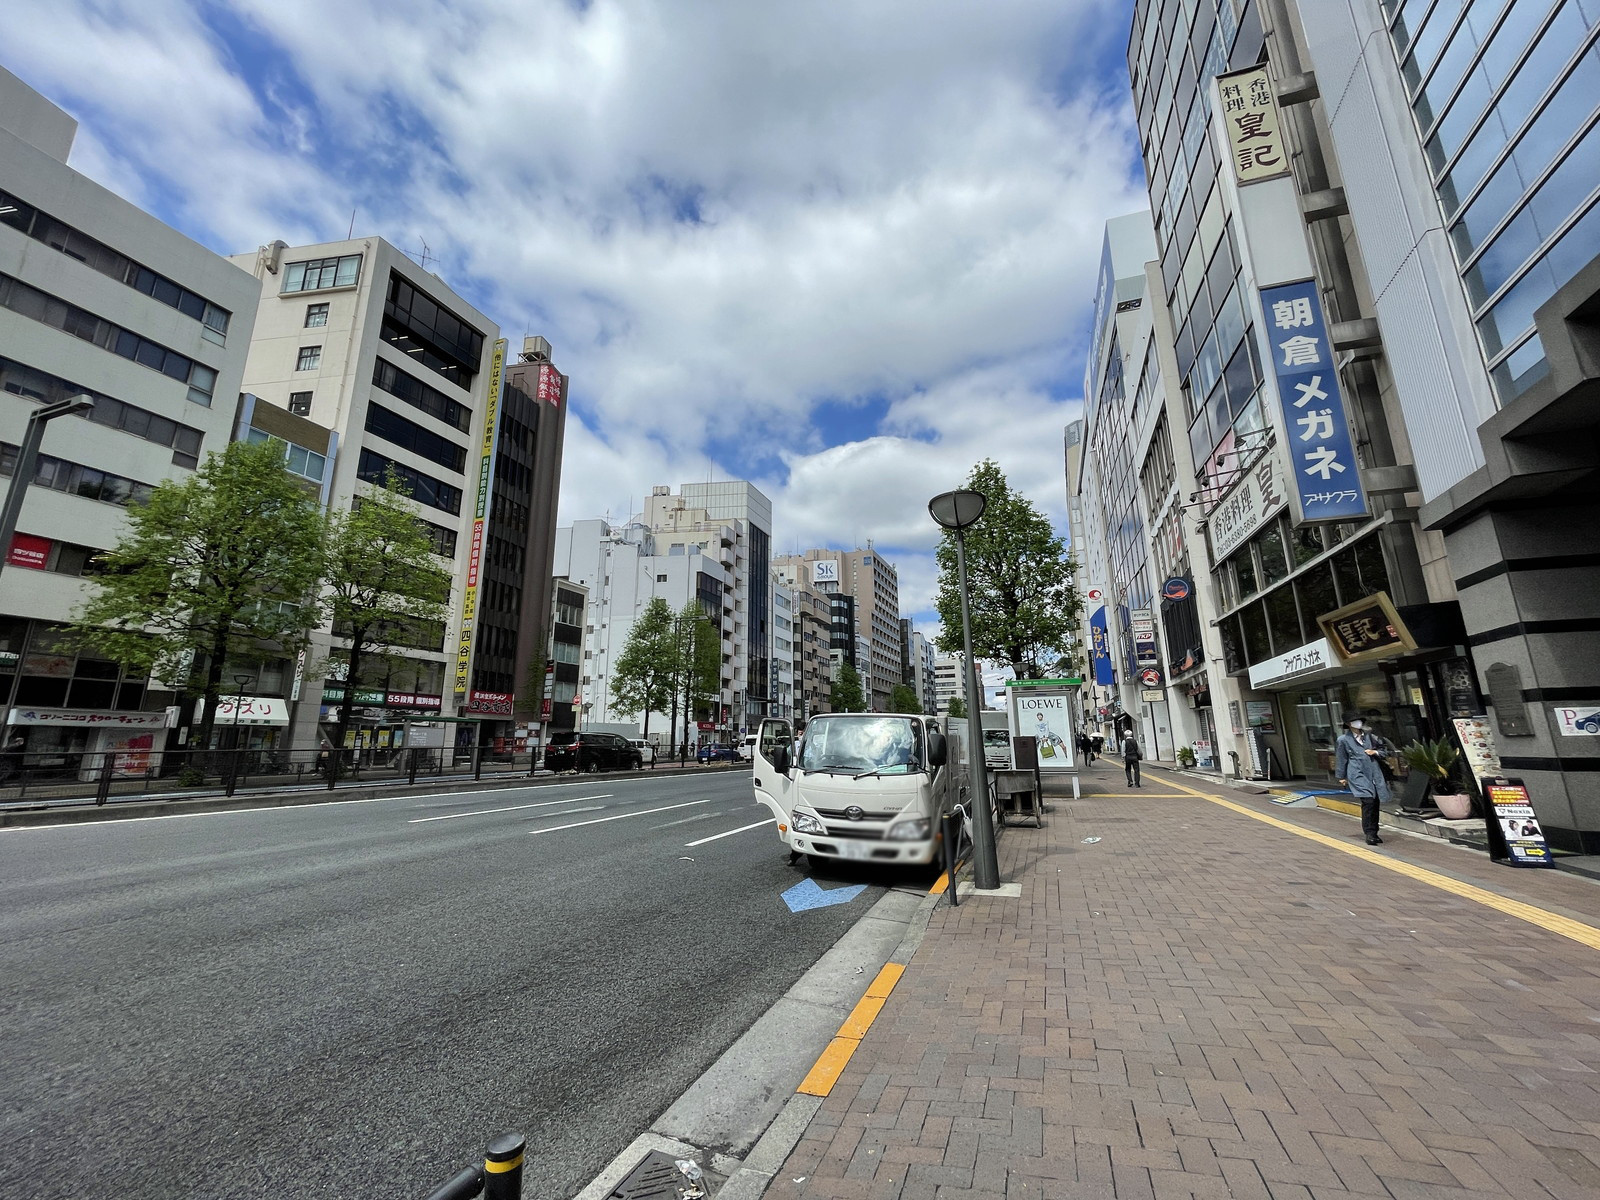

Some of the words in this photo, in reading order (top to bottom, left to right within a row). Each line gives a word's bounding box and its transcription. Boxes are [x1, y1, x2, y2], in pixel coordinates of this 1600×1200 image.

[1222, 84, 1246, 113] 料理
[1247, 78, 1271, 107] 香港
[1235, 112, 1281, 171] 皇記
[1272, 297, 1346, 480] 朝倉メガネ
[1254, 457, 1284, 517] 皇
[1304, 489, 1358, 506] アサクラ
[1214, 484, 1254, 542] 香港料理
[1092, 626, 1104, 659] ひがしん
[1338, 617, 1381, 649] 皇記
[456, 631, 471, 688] 四谷学院
[218, 702, 271, 715] クスリ
[1021, 698, 1063, 710] LOEWE
[1561, 709, 1577, 726] P
